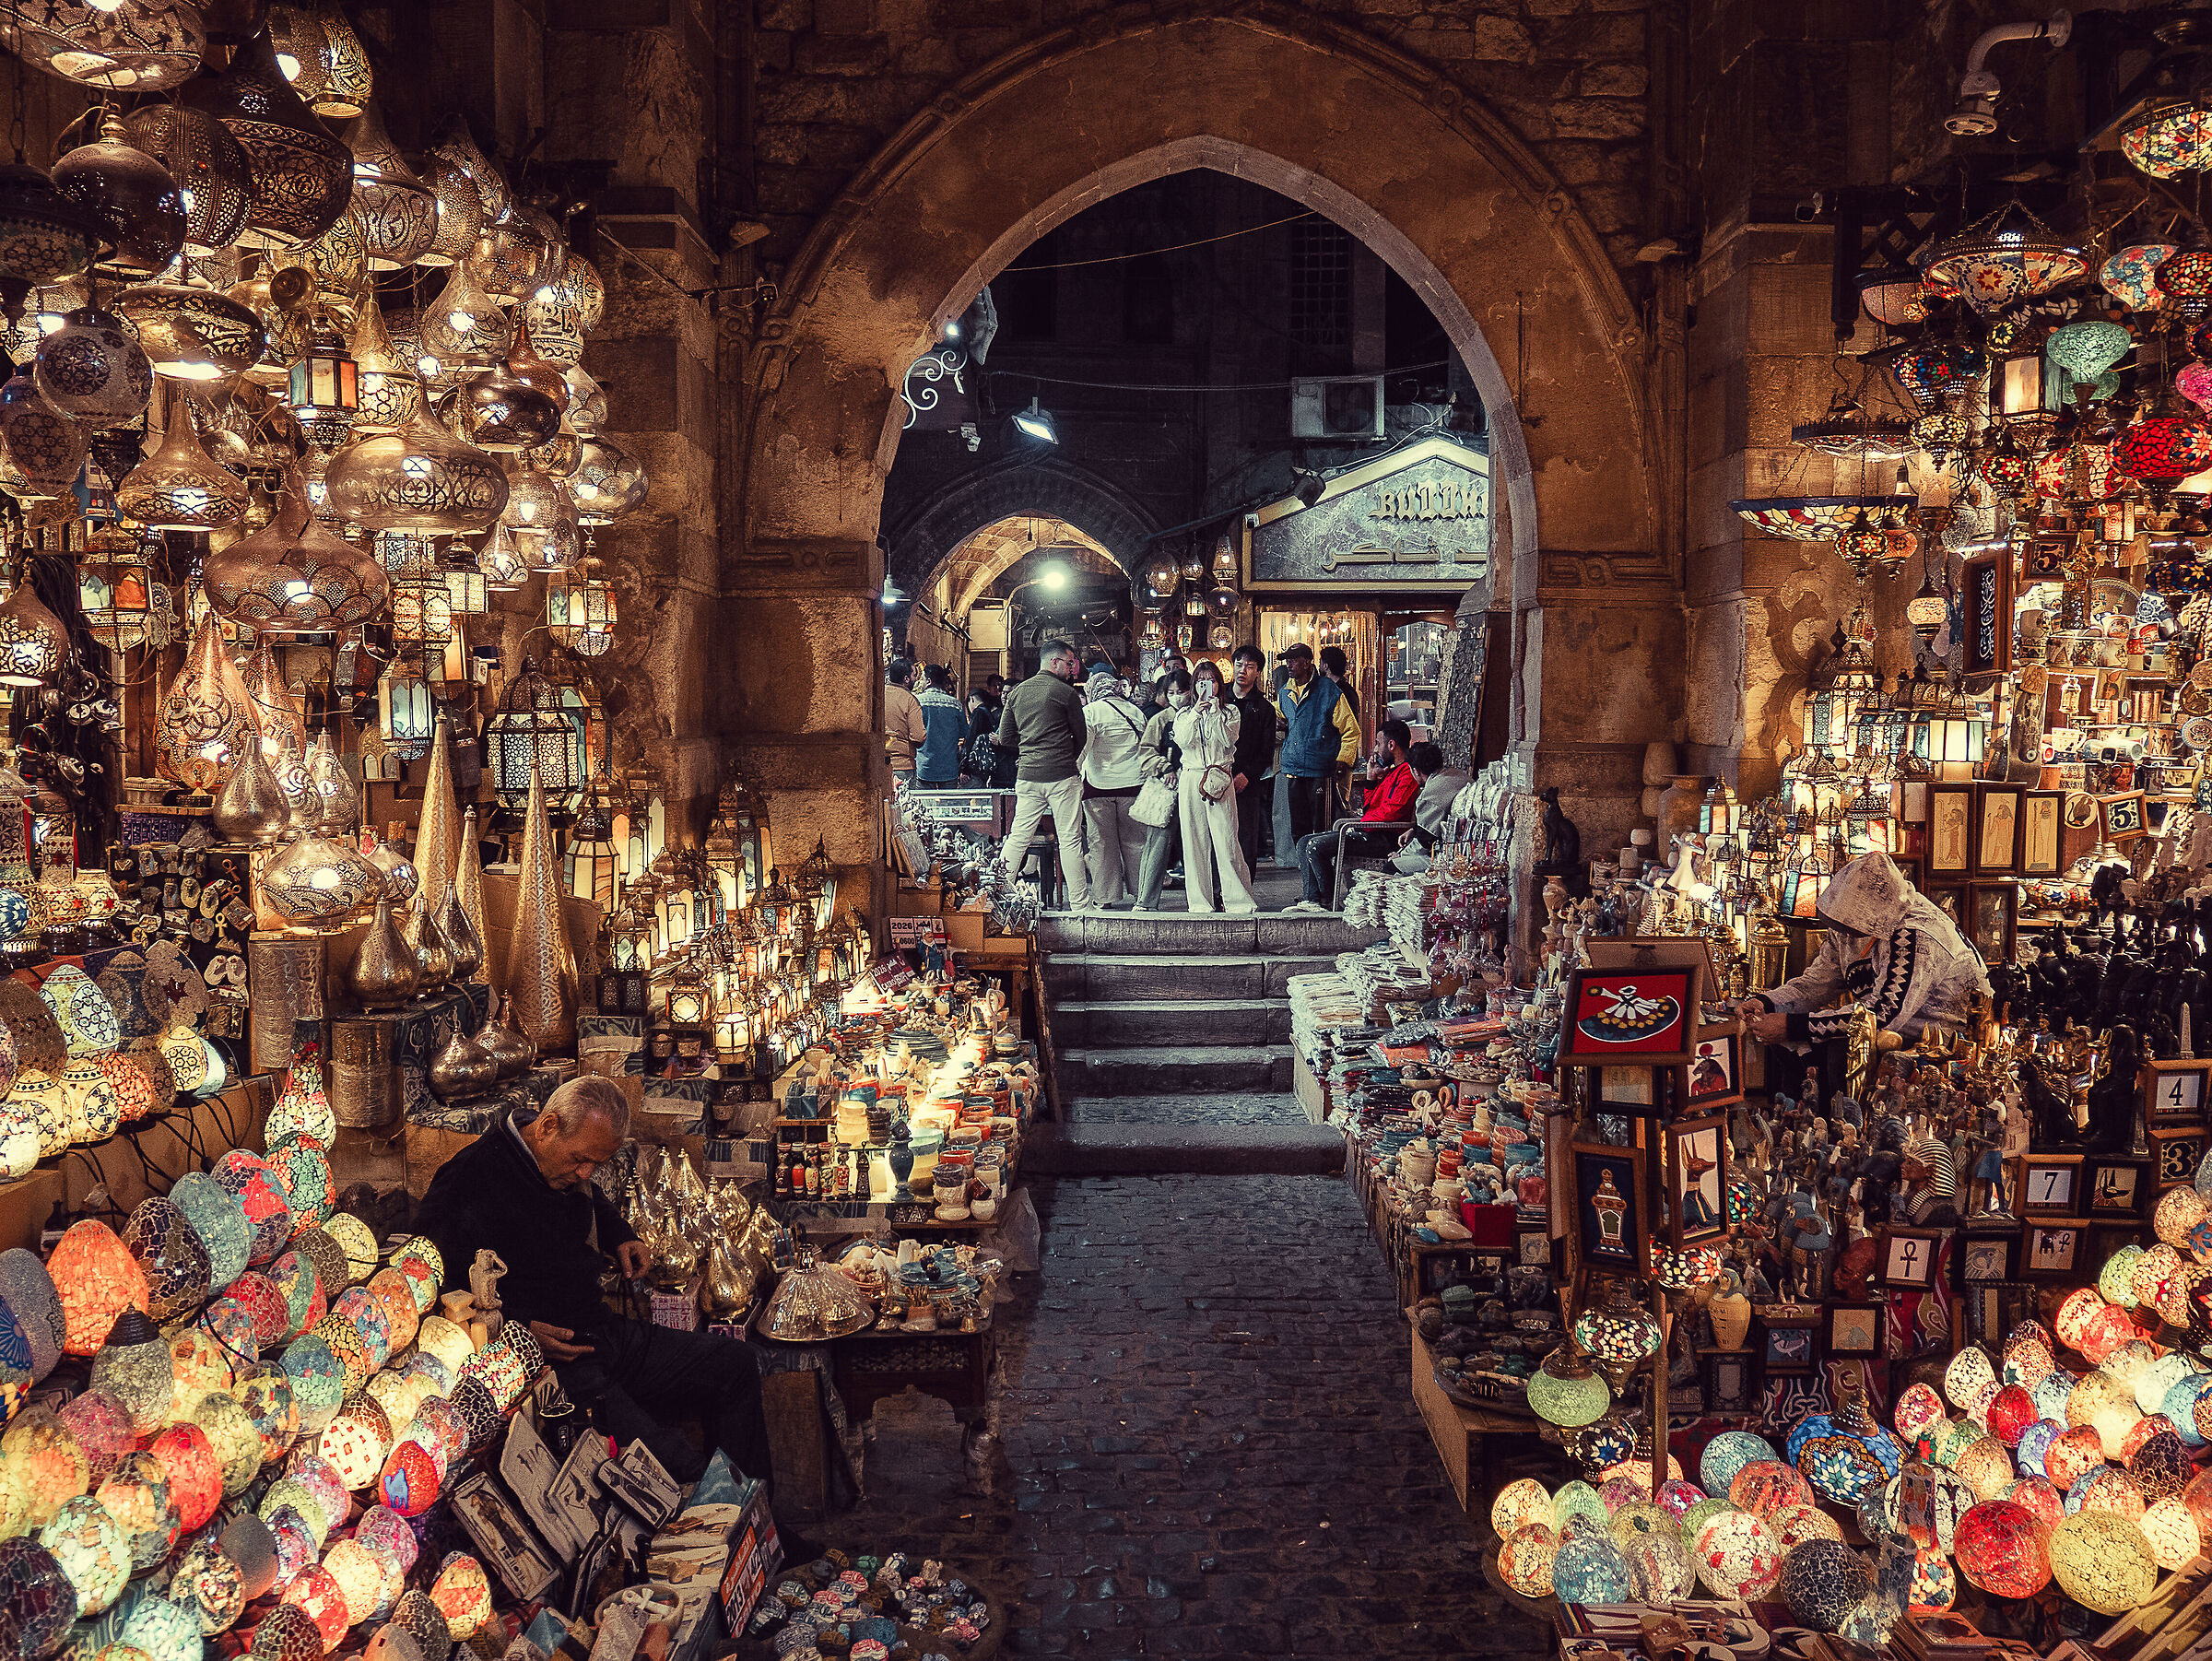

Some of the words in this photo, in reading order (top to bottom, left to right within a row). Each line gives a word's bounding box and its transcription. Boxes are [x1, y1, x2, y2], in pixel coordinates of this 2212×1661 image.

[2037, 544, 2058, 571] 5
[2114, 801, 2132, 828] 5
[892, 922, 912, 930] 2026
[871, 964, 888, 977] 2026
[2168, 1078, 2183, 1106] 4
[2166, 1142, 2194, 1178] 3
[2044, 1172, 2058, 1201] 7
